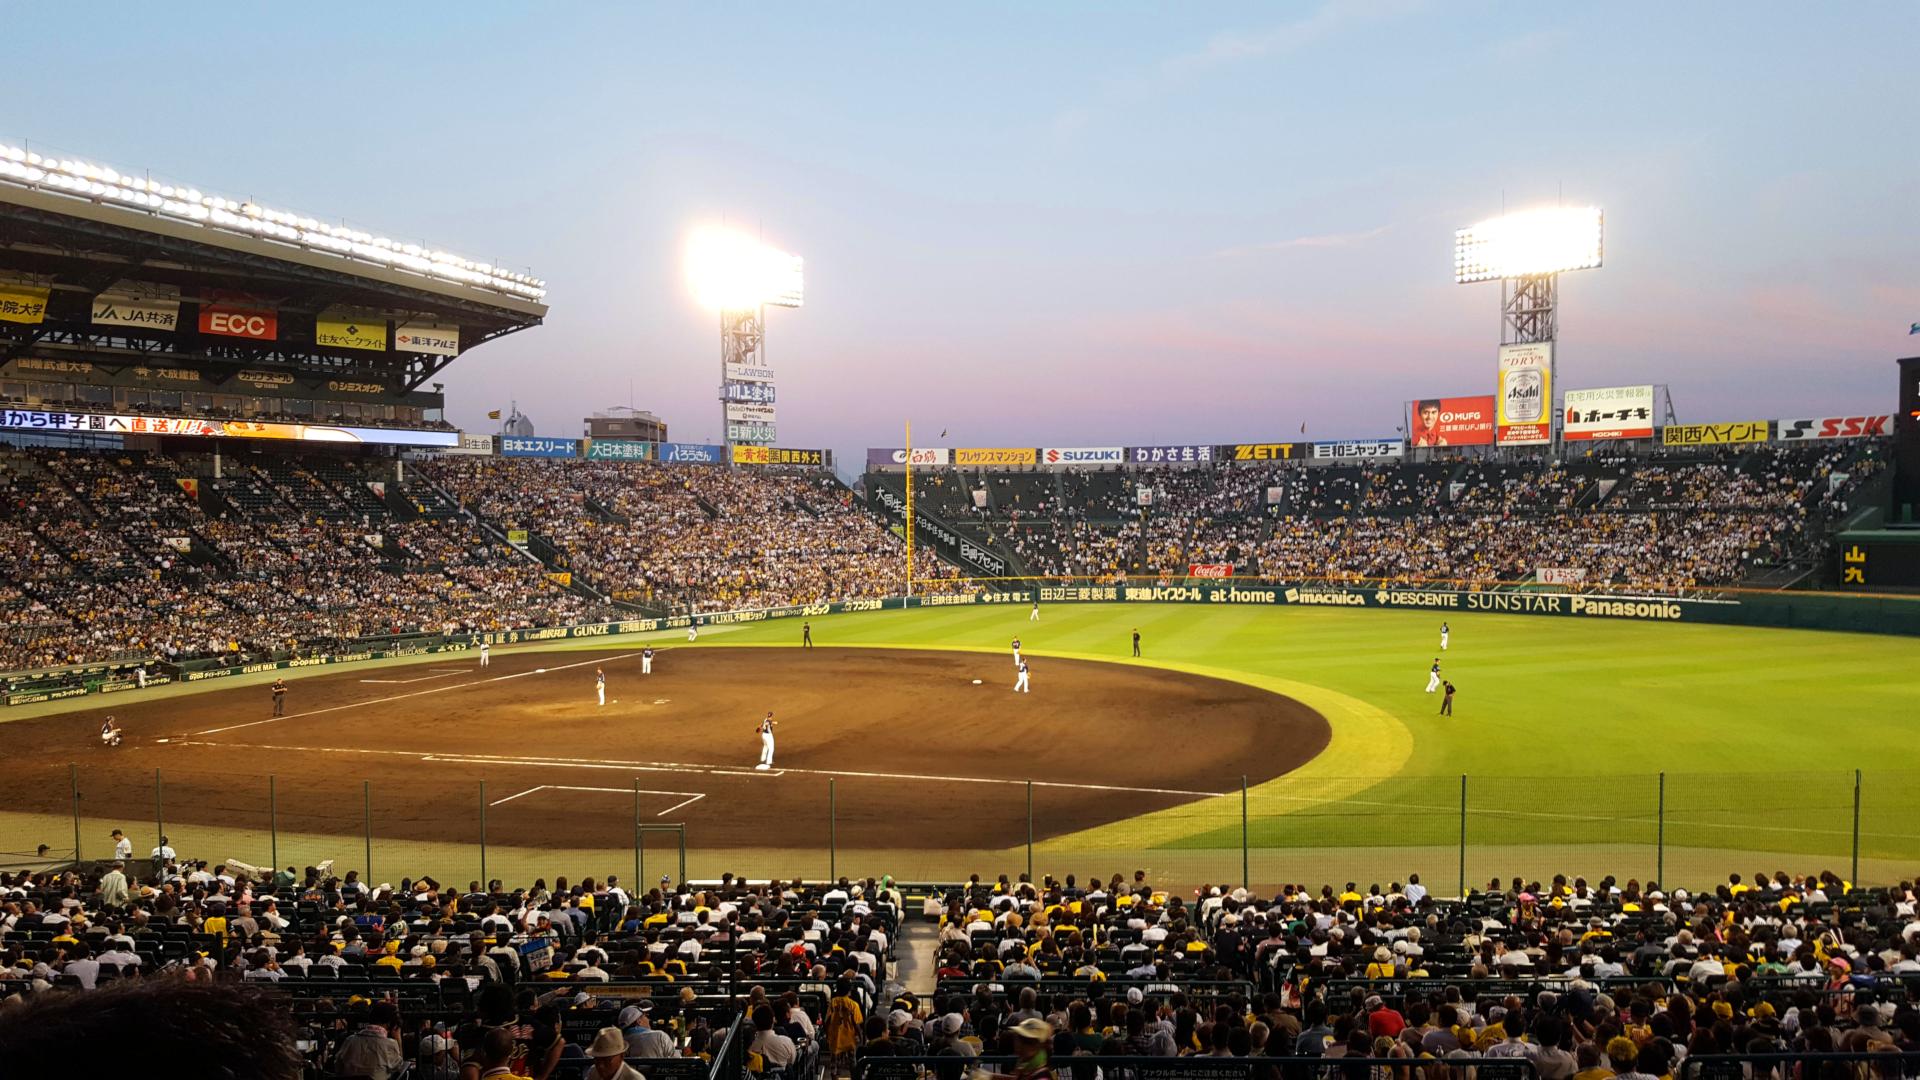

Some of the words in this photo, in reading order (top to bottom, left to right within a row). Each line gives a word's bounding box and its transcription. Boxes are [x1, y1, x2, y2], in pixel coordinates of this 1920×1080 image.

[122, 309, 176, 326] JA共済
[210, 312, 265, 336] ECC
[318, 332, 387, 349] 住友ベークライト
[737, 367, 775, 378] LAWSON
[338, 380, 385, 393] シミズオクト
[1508, 384, 1539, 399] Asahi
[1455, 411, 1481, 421] MUFG
[1584, 407, 1651, 423] ホーチキ
[729, 425, 775, 441] 日新火災
[1818, 415, 1889, 437] SSK
[1665, 425, 1766, 444] 関西ペイント
[504, 440, 574, 453] 日本エスリード
[1137, 446, 1210, 462] わかさ生活
[1234, 444, 1293, 460] ZETT
[1319, 444, 1397, 457] 三和シャッター
[680, 450, 711, 462] ろうきん
[781, 450, 821, 464] 関西外大
[1063, 451, 1120, 461] SUZUKI
[1844, 545, 1866, 583] 山九
[1125, 588, 1201, 601] 東進ハイスクール
[1210, 588, 1227, 602] at
[1229, 586, 1276, 602] home
[1391, 592, 1458, 606] DESCENTE
[1467, 594, 1560, 612] SUNSTAR
[1571, 597, 1682, 619] Panasonic
[573, 624, 609, 637] GUNZE
[470, 632, 519, 645] 大和証券
[262, 663, 277, 671] MAX
